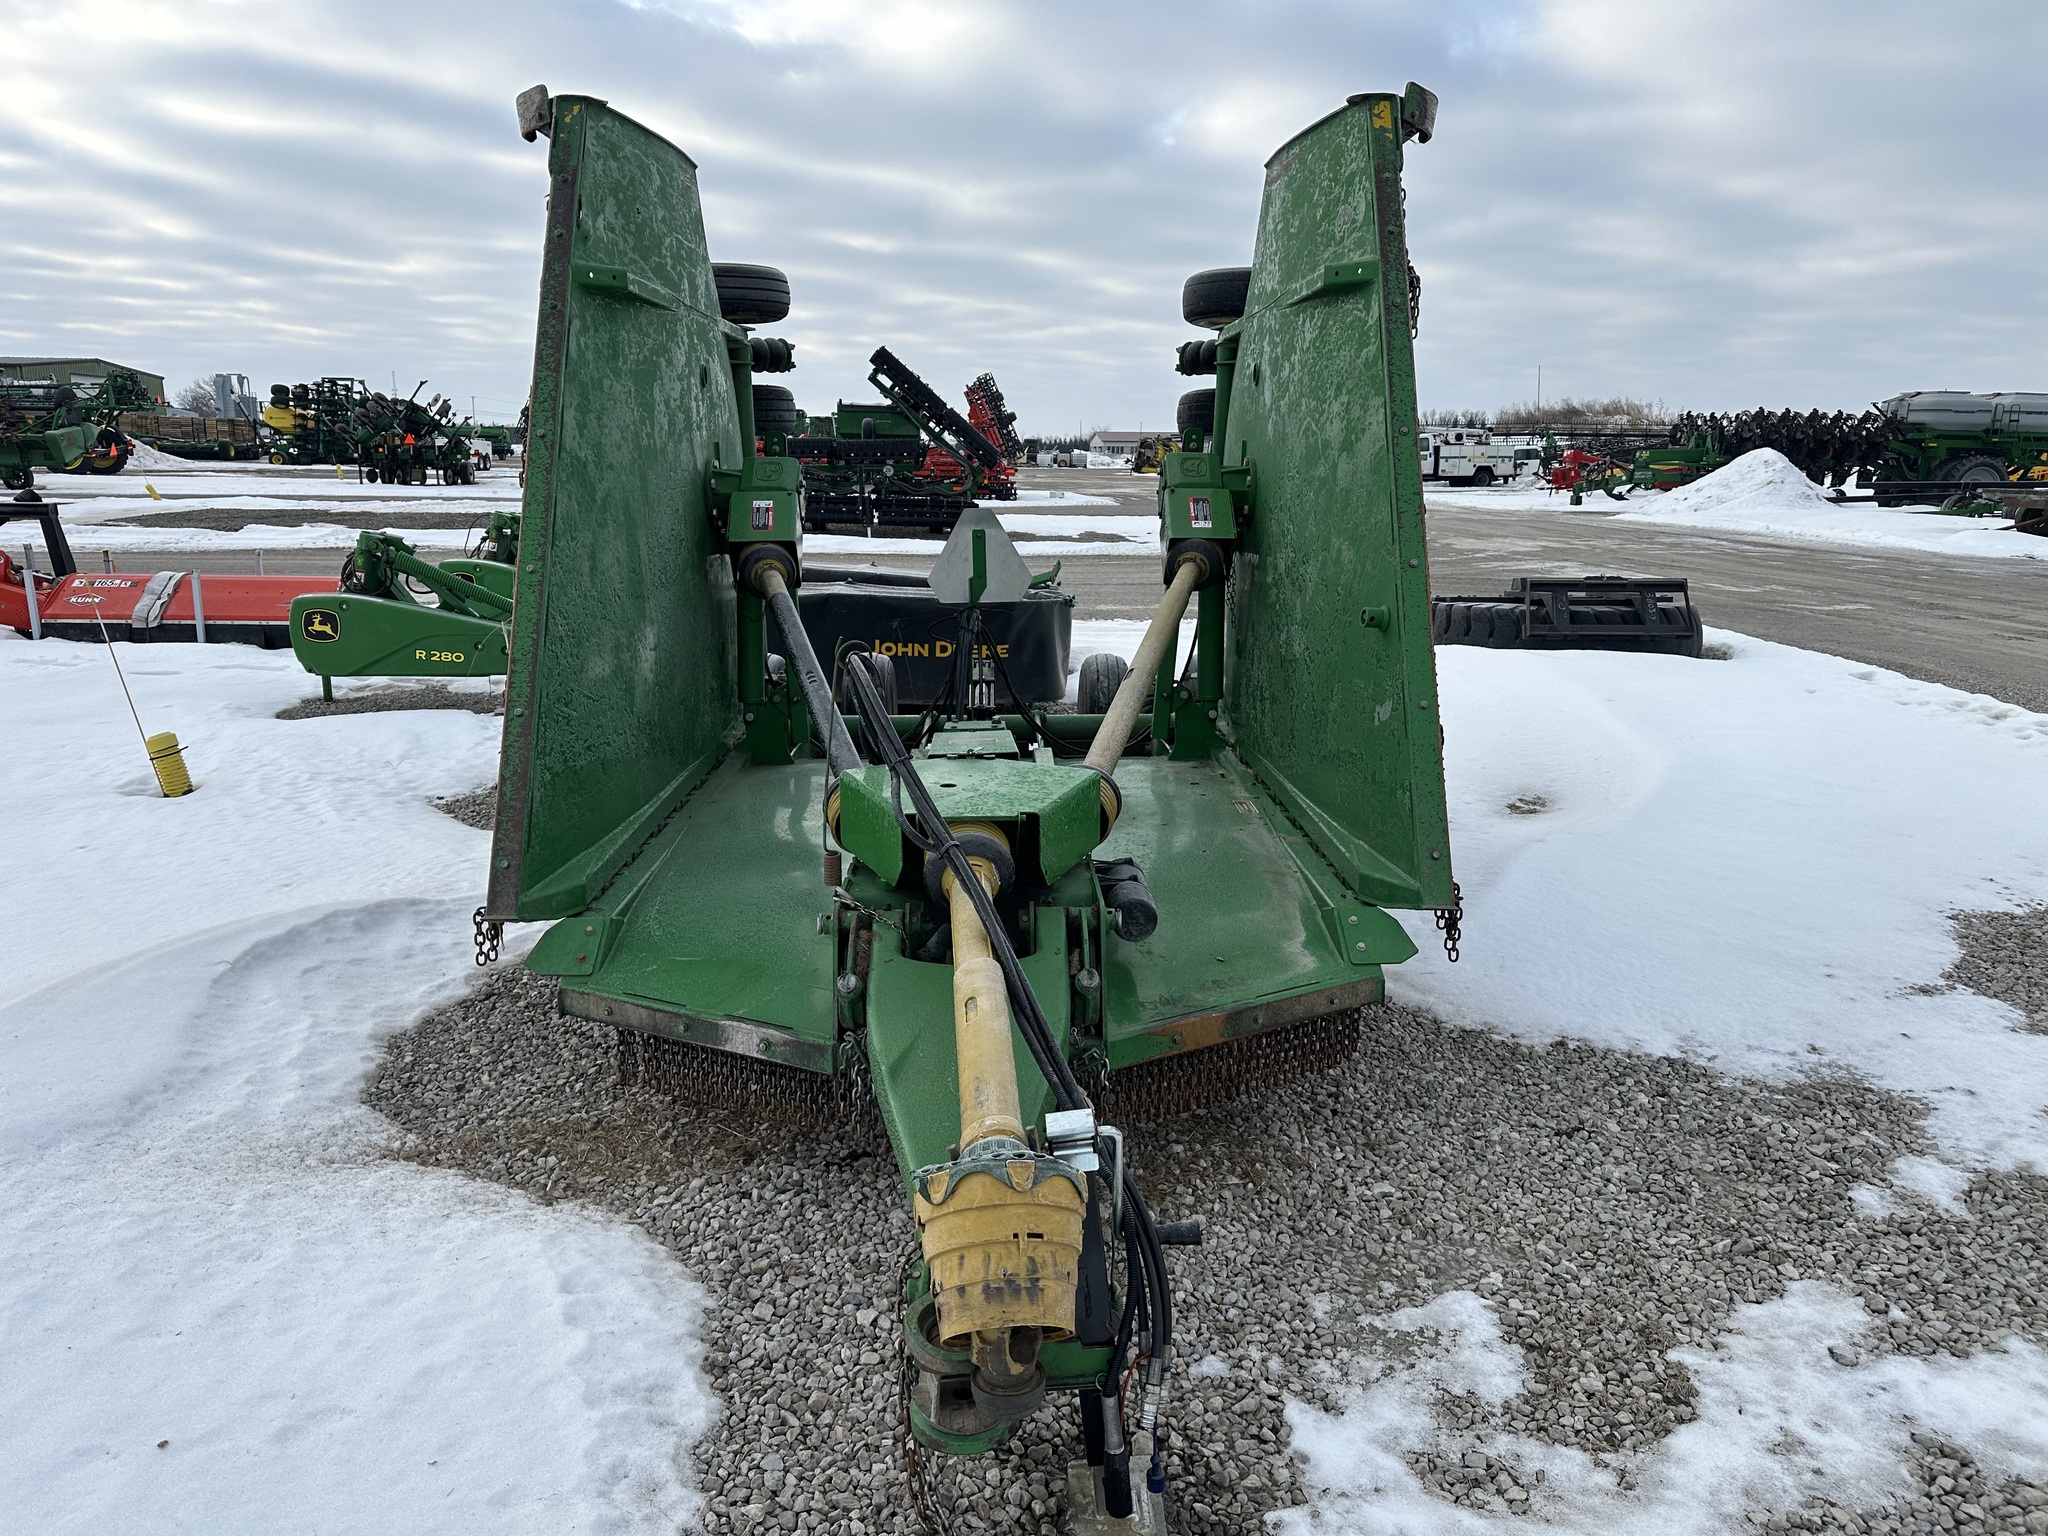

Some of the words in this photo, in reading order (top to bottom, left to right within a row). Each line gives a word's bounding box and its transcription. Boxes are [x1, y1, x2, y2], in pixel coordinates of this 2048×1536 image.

[415, 649, 426, 660] R
[430, 650, 465, 663] 280
[872, 639, 929, 657] JOHN
[935, 641, 1009, 658] DERE
